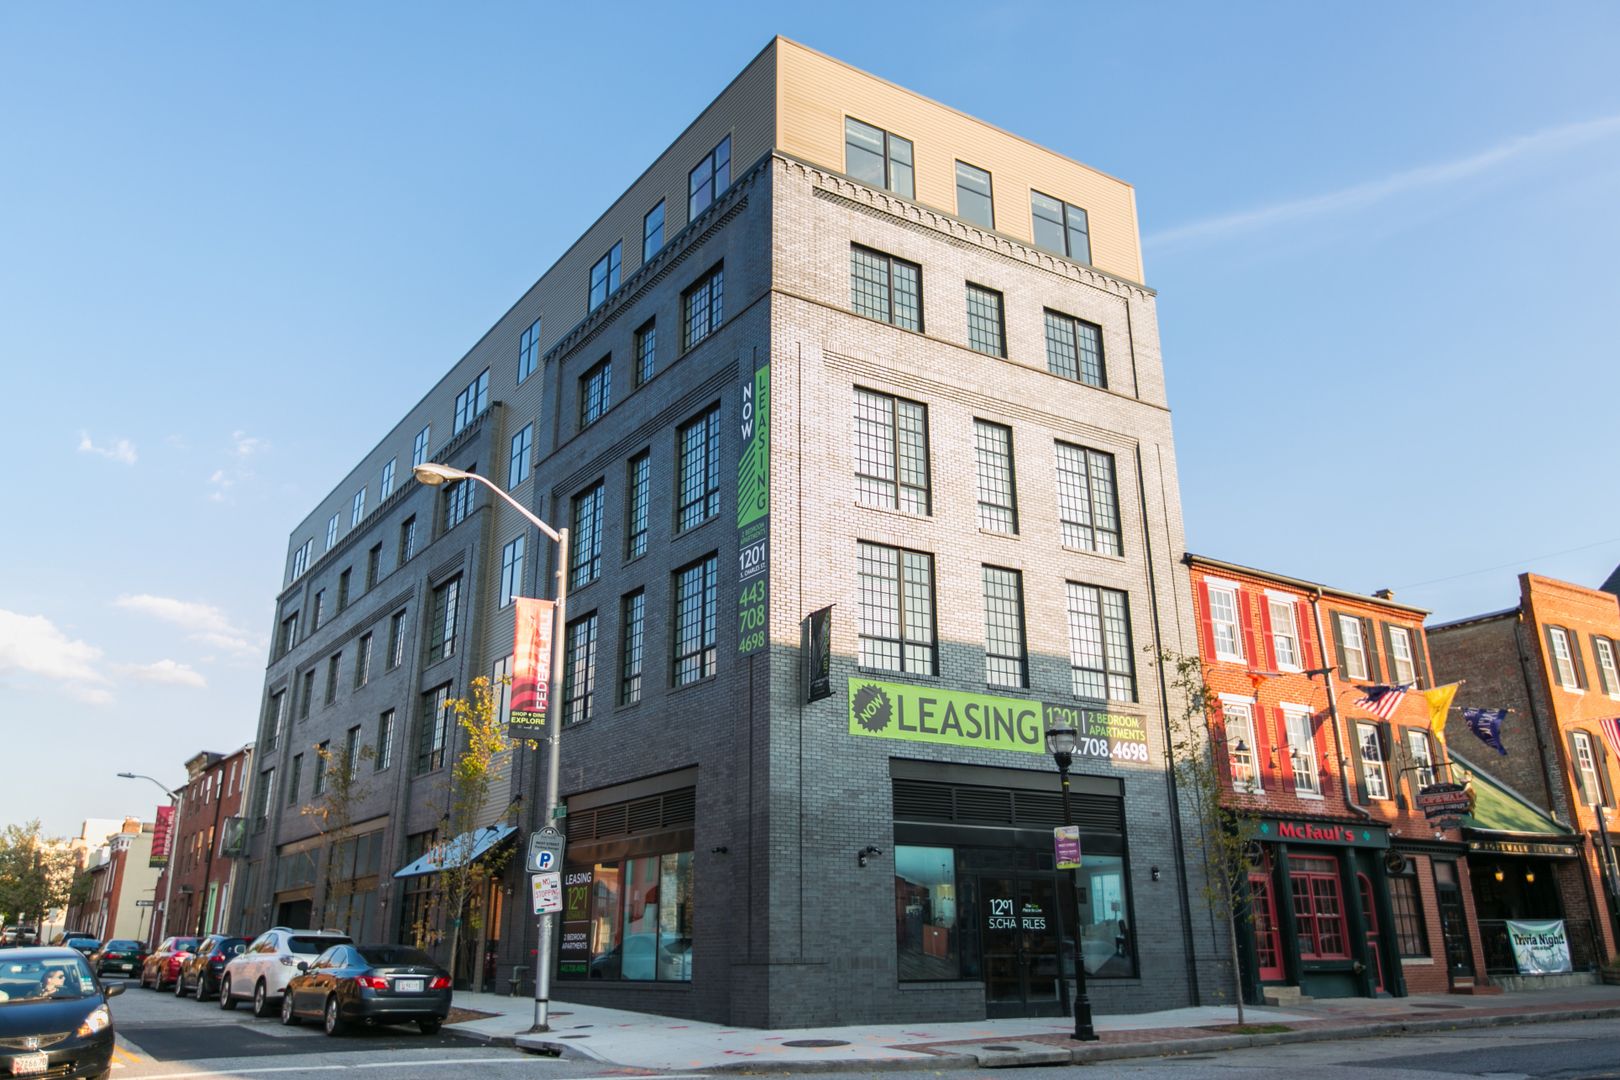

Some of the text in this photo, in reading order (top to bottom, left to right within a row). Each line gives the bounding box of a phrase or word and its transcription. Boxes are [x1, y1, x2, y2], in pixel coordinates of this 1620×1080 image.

[741, 382, 754, 441] NOW
[756, 375, 767, 510] LEASING
[739, 542, 765, 571] 1201
[740, 579, 765, 605] 443
[739, 604, 765, 633] 708
[738, 631, 765, 653] 4698
[535, 643, 551, 710] FEDERAL
[859, 694, 884, 723] NOW
[897, 695, 1040, 745] LEASING
[1088, 712, 1139, 728] 2 BEDROOM
[510, 717, 546, 726] EXPLORE
[1089, 725, 1146, 741] APARTMENTS
[1278, 822, 1355, 842] McFaul's
[539, 853, 551, 867] P
[565, 872, 592, 885] LEASING
[567, 886, 588, 910] 1201
[989, 899, 1013, 915] 1201
[1512, 932, 1566, 947] Trivia Night!
